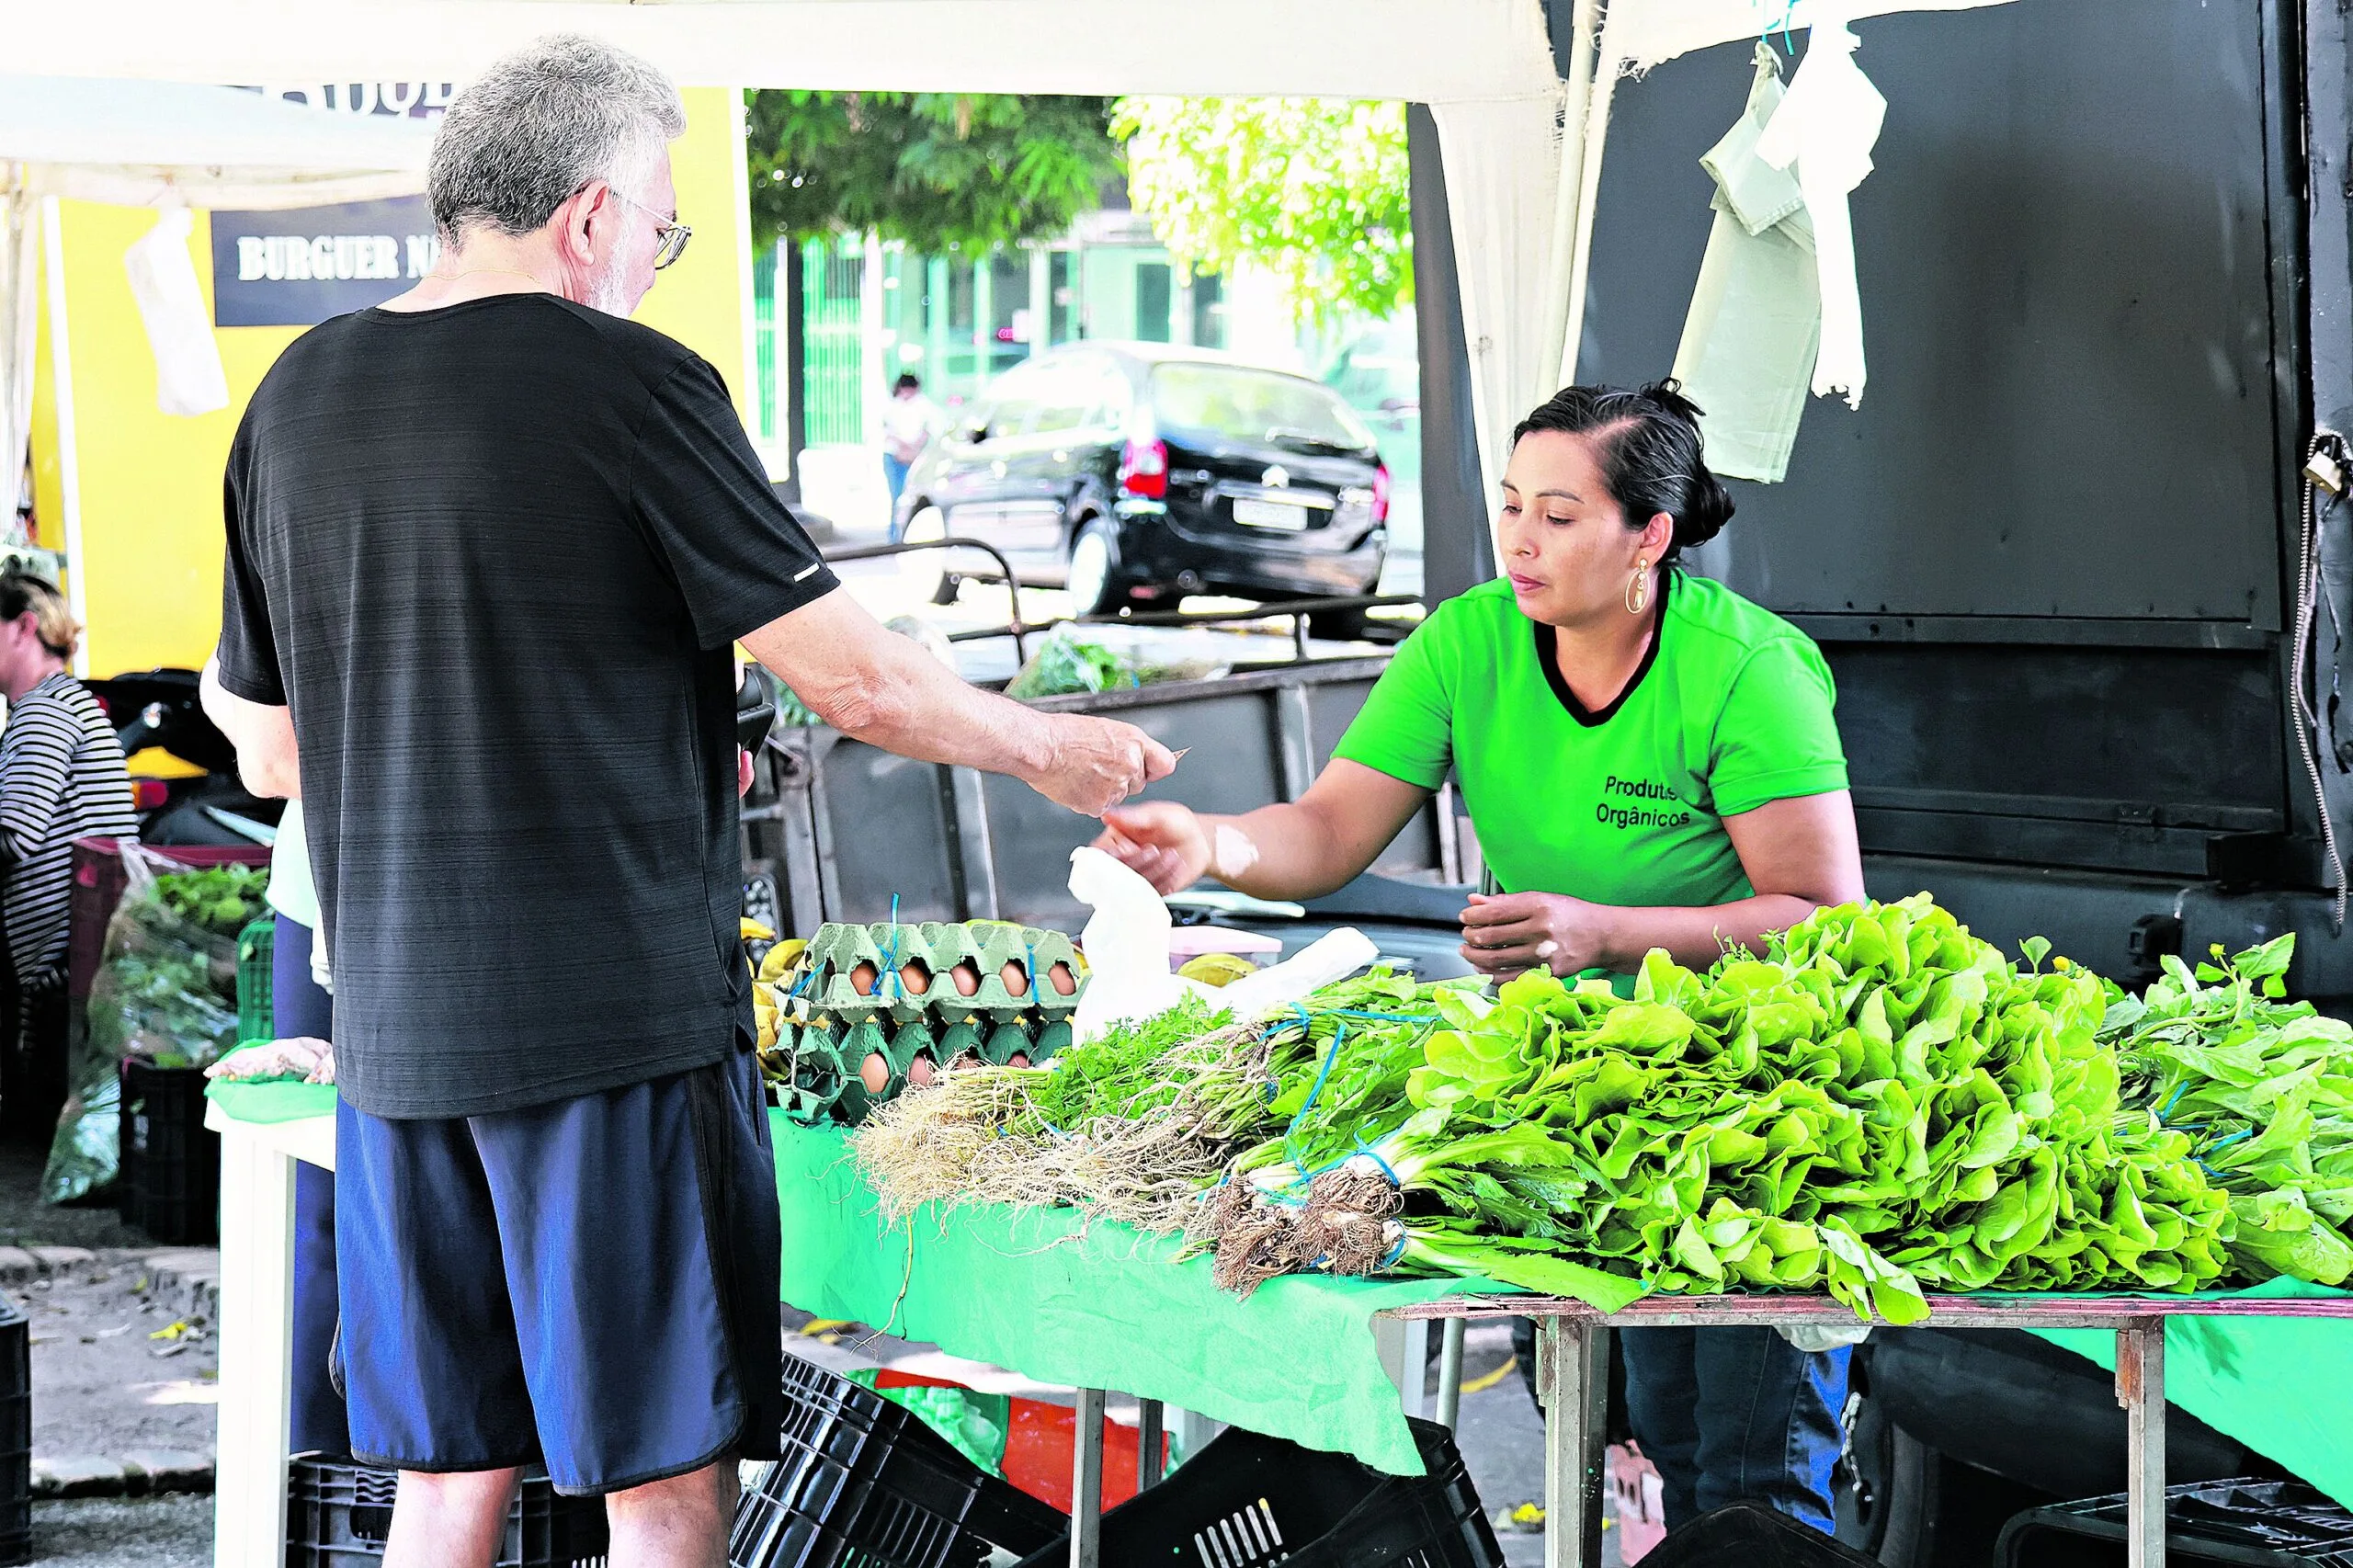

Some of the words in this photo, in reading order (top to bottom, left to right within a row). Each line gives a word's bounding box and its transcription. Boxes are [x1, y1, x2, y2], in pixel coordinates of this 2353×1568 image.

[237, 235, 399, 280] BURGUER
[1605, 776, 1677, 801] Produts
[1597, 802, 1690, 829] Orgânicos
